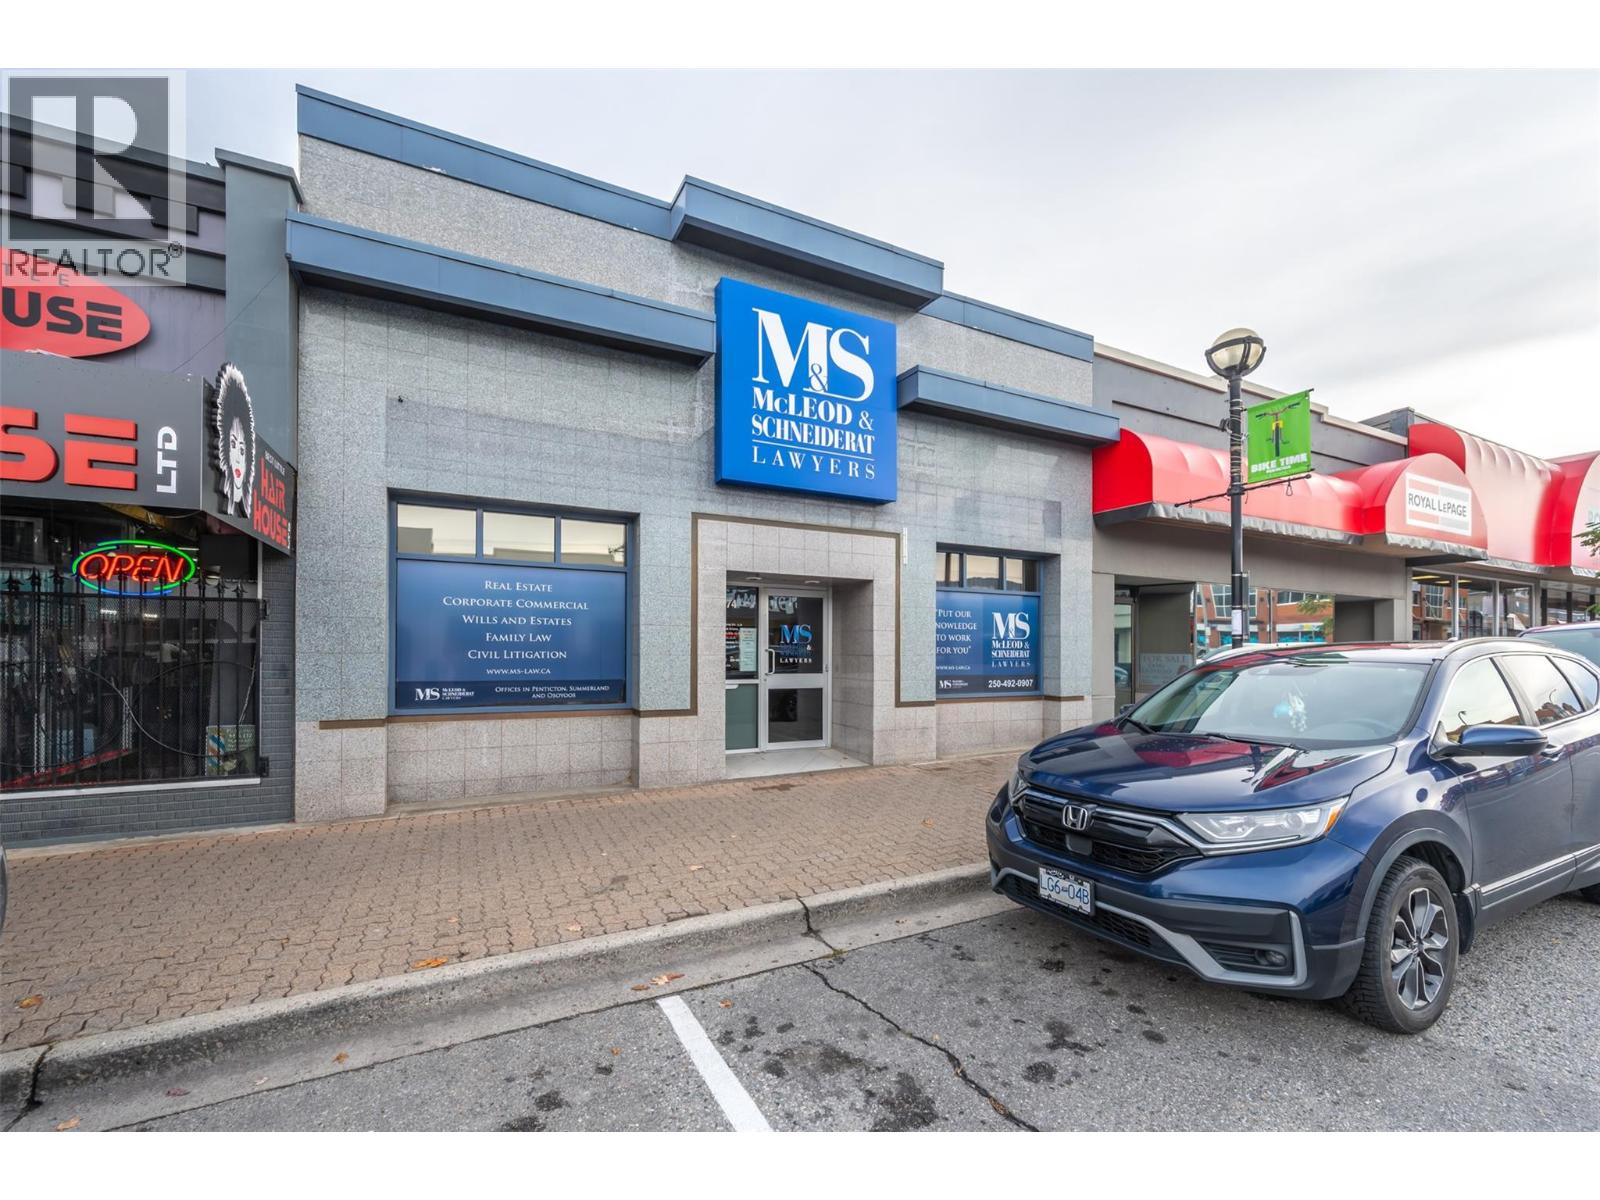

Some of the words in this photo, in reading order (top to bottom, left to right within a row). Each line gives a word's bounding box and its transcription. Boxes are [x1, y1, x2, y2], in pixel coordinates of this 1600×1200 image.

[2, 287, 122, 342] USE
[752, 386, 852, 426] McLEOD
[858, 410, 874, 432] &
[752, 414, 875, 455] SCHNEIDERAT
[0, 405, 138, 490] SE
[156, 426, 177, 494] LTD
[752, 446, 875, 480] LAWYERS
[1251, 459, 1277, 473] BIKE
[1279, 452, 1308, 466] TIME
[261, 457, 285, 515] HAIR
[1408, 492, 1437, 510] ROYAL
[253, 488, 288, 549] HOUSE
[79, 553, 186, 583] OPEN
[484, 580, 512, 591] REAL
[516, 582, 553, 593] ESTATE
[442, 596, 513, 608] CORPORATE
[516, 599, 589, 610] COMMERCIAL
[462, 614, 498, 625] WILLS
[501, 616, 527, 625] AND
[530, 616, 573, 626] ESTATES
[954, 610, 972, 618] OUR
[485, 632, 526, 642] FAMILY
[529, 633, 552, 642] LAW
[936, 634, 947, 642] TO
[948, 634, 972, 642] WORK
[467, 649, 500, 659] CIVIL
[503, 649, 567, 659] LITIGATION
[936, 646, 952, 654] FOR
[988, 679, 1034, 688] 250-492-0907
